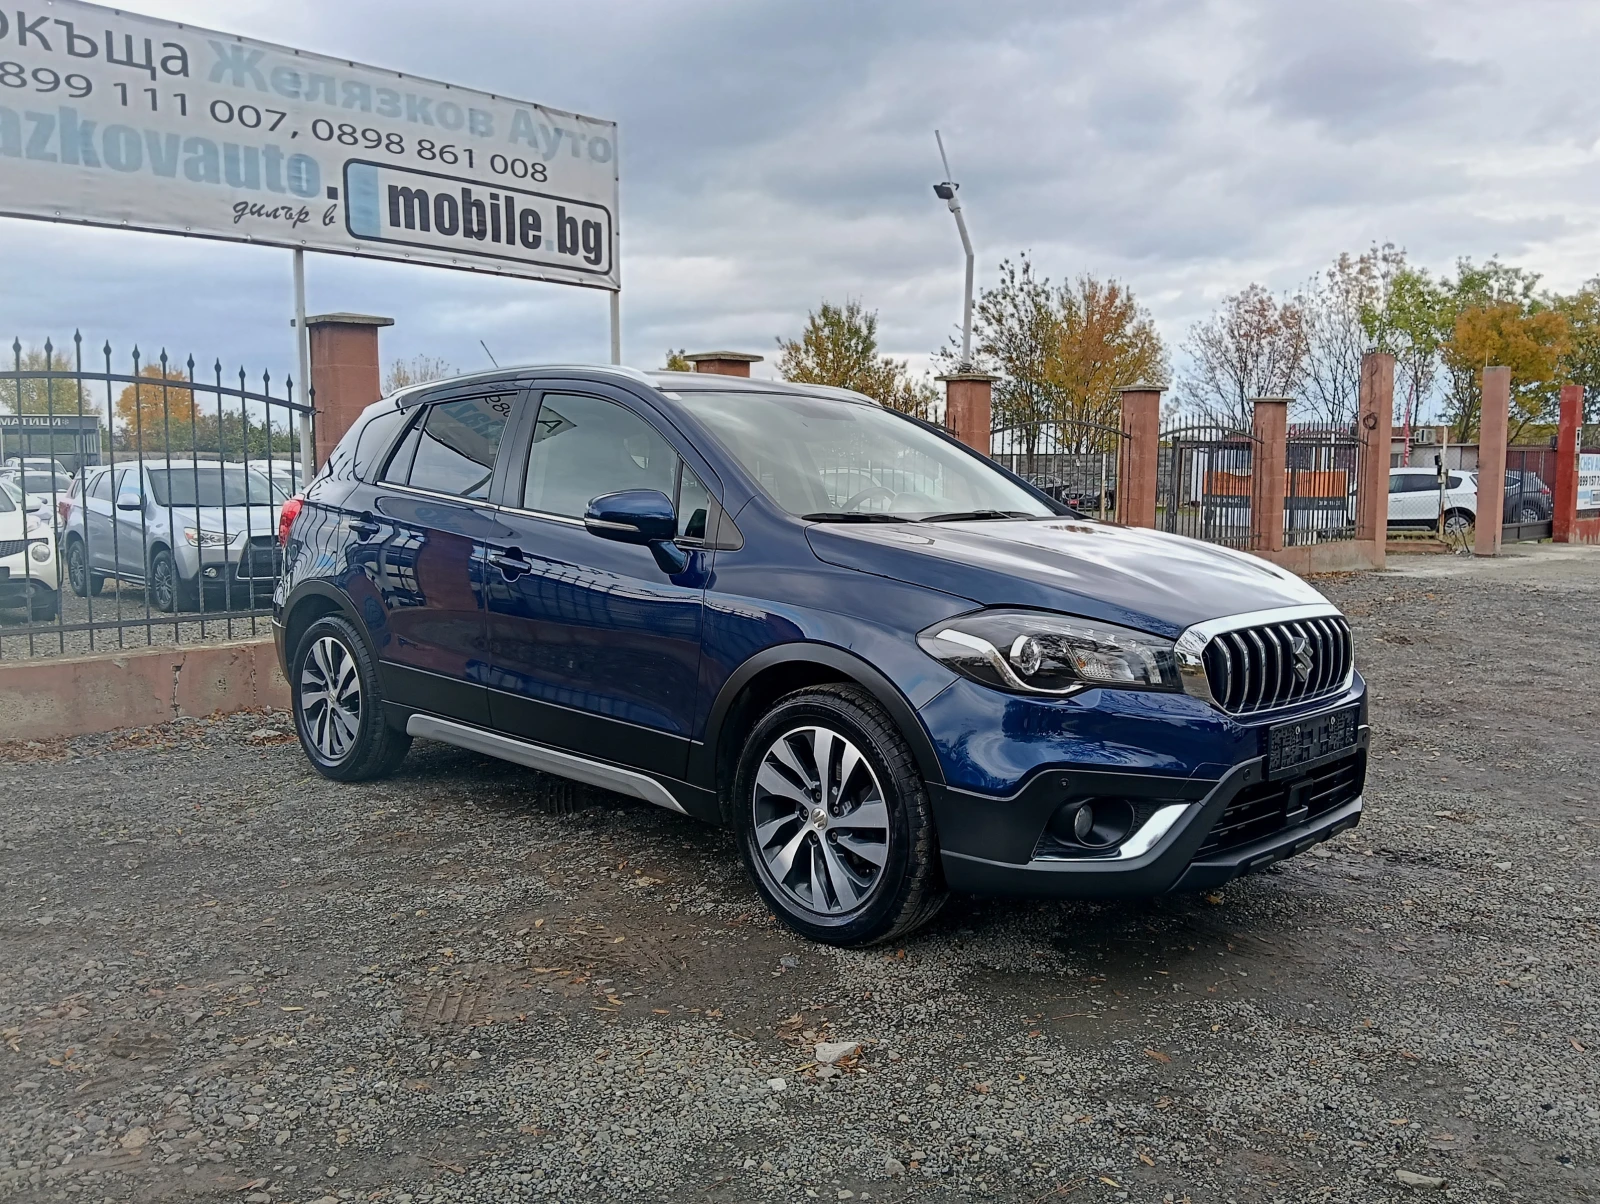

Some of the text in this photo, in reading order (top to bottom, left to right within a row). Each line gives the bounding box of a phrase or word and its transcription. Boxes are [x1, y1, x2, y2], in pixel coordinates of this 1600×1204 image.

[0, 9, 612, 163] къща Желязков Ауто
[113, 82, 187, 116] 111
[209, 100, 299, 139] 007,
[311, 119, 405, 154] 0898
[417, 139, 474, 169] 861
[490, 154, 548, 183] 008
[233, 201, 337, 229] дилър в
[387, 184, 603, 266] mobile.bg
